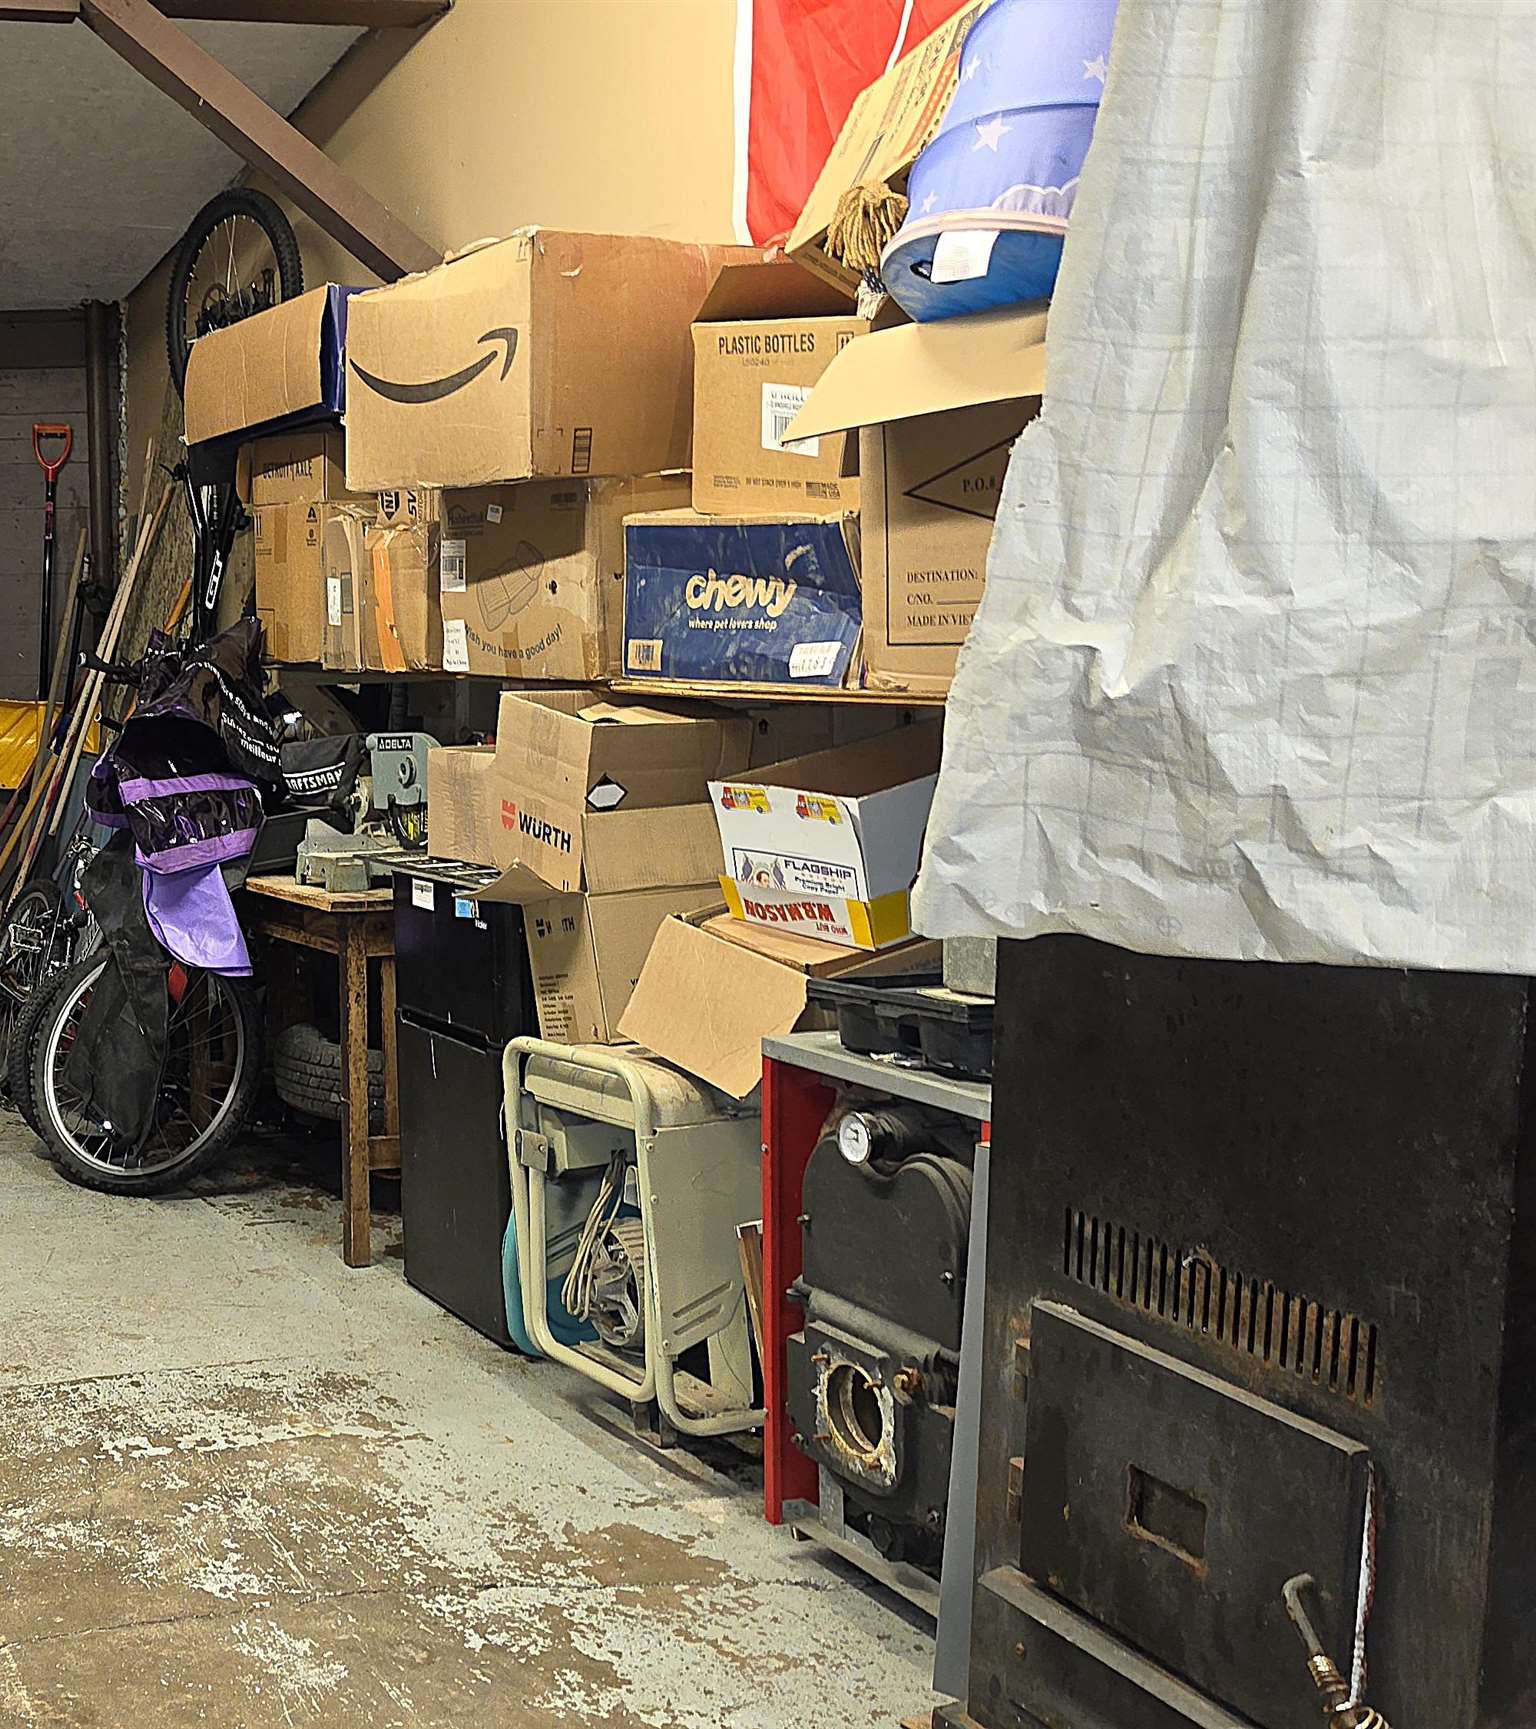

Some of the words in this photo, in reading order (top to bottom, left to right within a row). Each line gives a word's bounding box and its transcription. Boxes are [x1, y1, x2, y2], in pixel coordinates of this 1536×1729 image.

[718, 335, 761, 355] PLASTIC
[765, 333, 815, 353] BOTTLES
[907, 568, 978, 583] DESTINATION:
[686, 568, 797, 617] chewy
[688, 616, 713, 629] where
[713, 618, 728, 632] pet
[729, 617, 753, 629] lovers
[754, 617, 777, 632] shop
[906, 614, 936, 627] MADE
[938, 614, 949, 626] IN
[482, 640, 496, 655] you
[498, 645, 517, 659] have
[518, 648, 524, 659] a
[525, 638, 546, 660] good
[546, 623, 563, 647] day!
[385, 739, 412, 749] DELTA
[784, 860, 852, 879] FLAGSHIP
[744, 898, 836, 923] W.B.MASON
